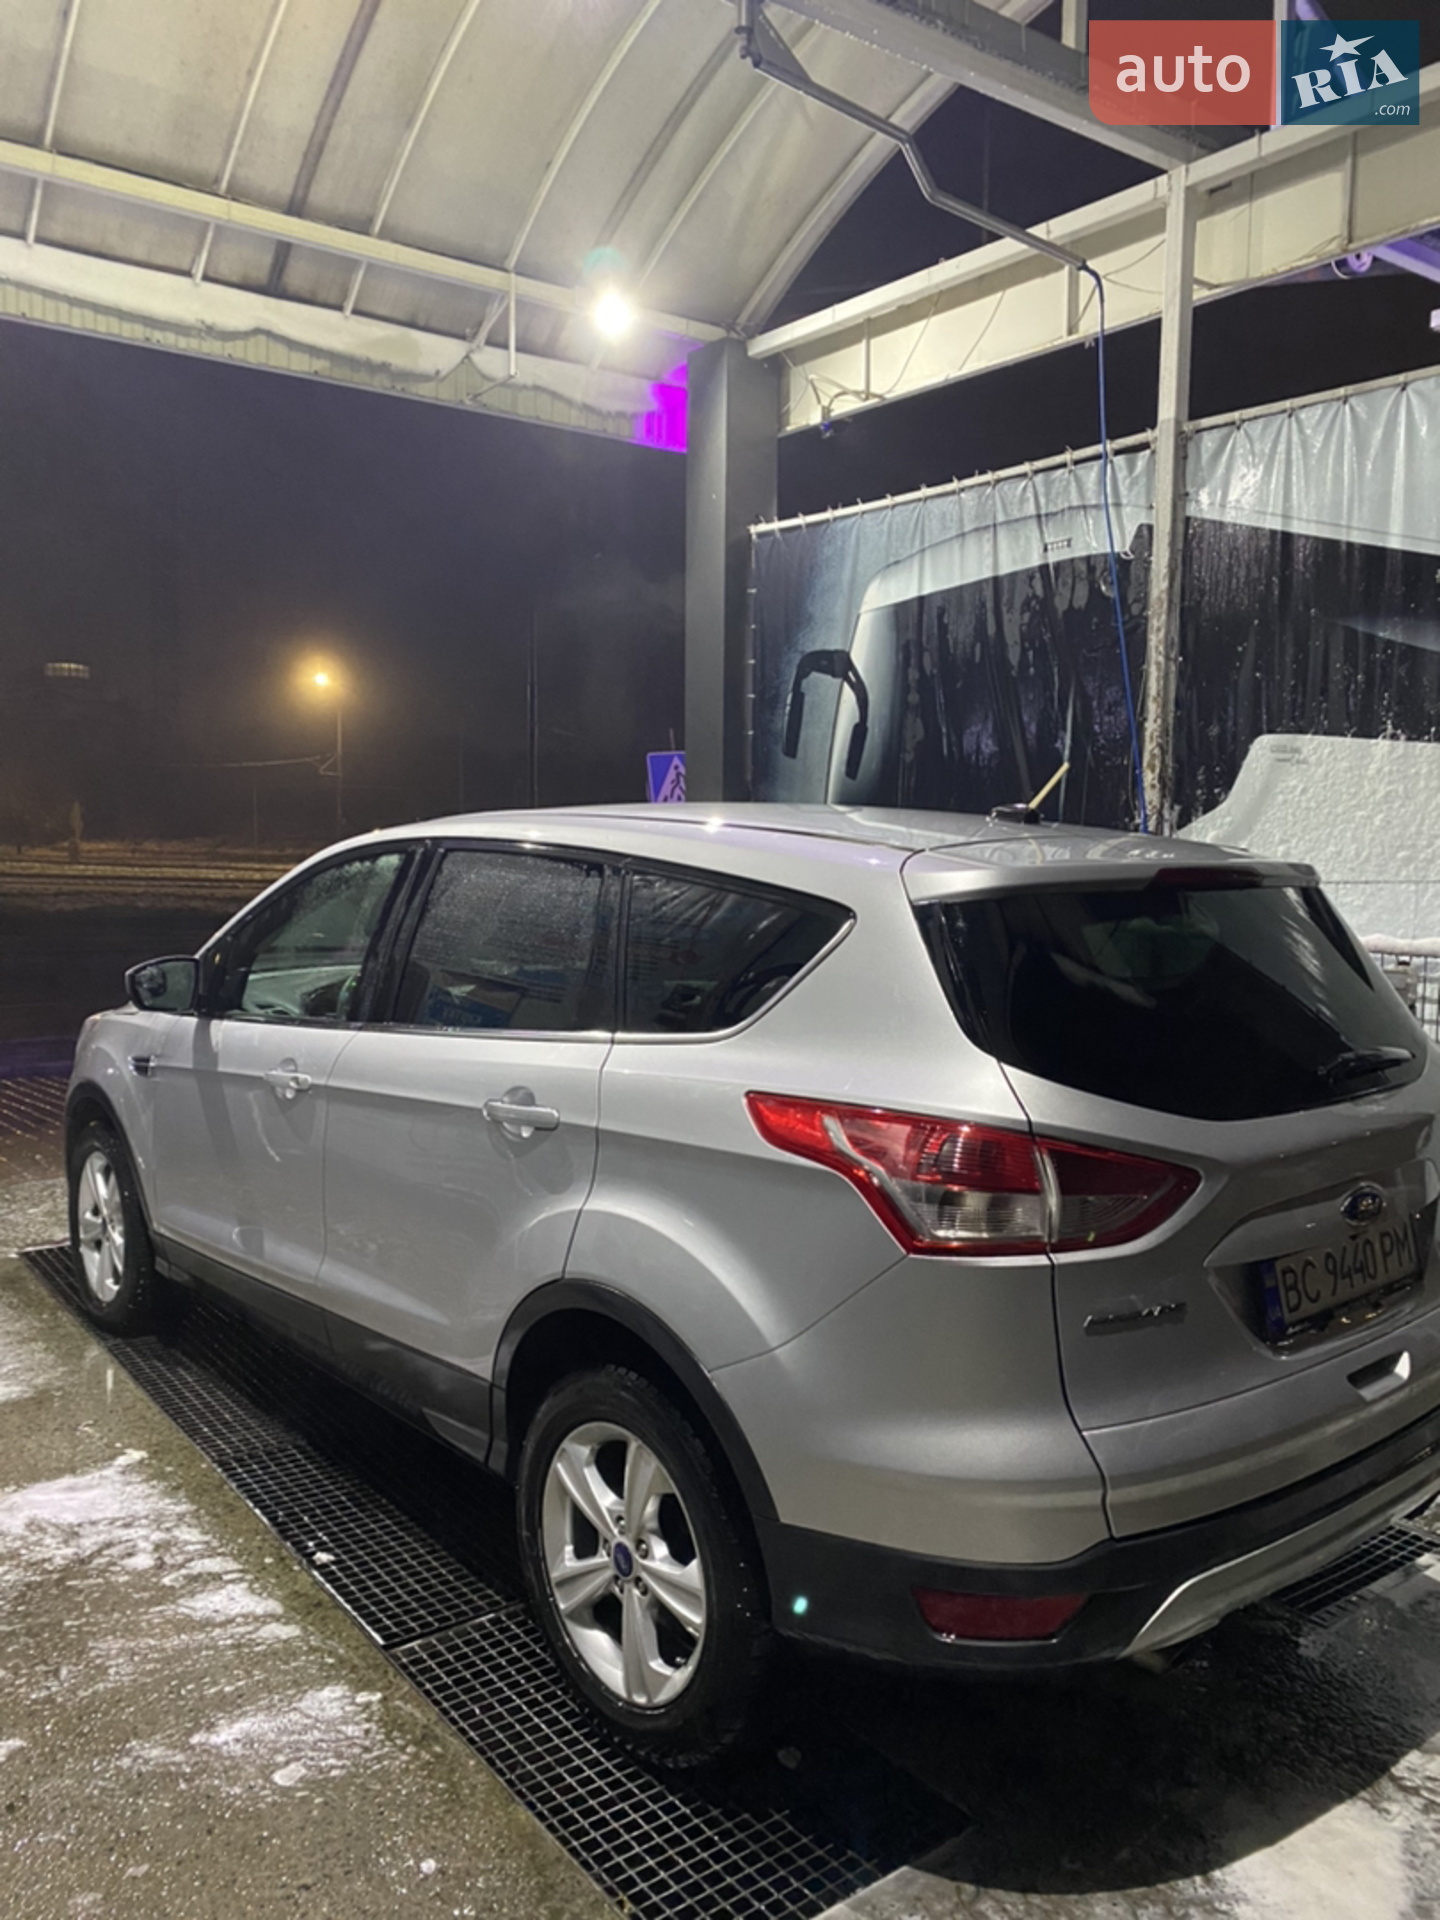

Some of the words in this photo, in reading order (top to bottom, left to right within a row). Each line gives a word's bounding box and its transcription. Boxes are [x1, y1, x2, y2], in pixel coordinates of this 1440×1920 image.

[1281, 1258, 1321, 1314] BC
[1324, 1237, 1377, 1296] 9440
[1379, 1223, 1413, 1275] PM
